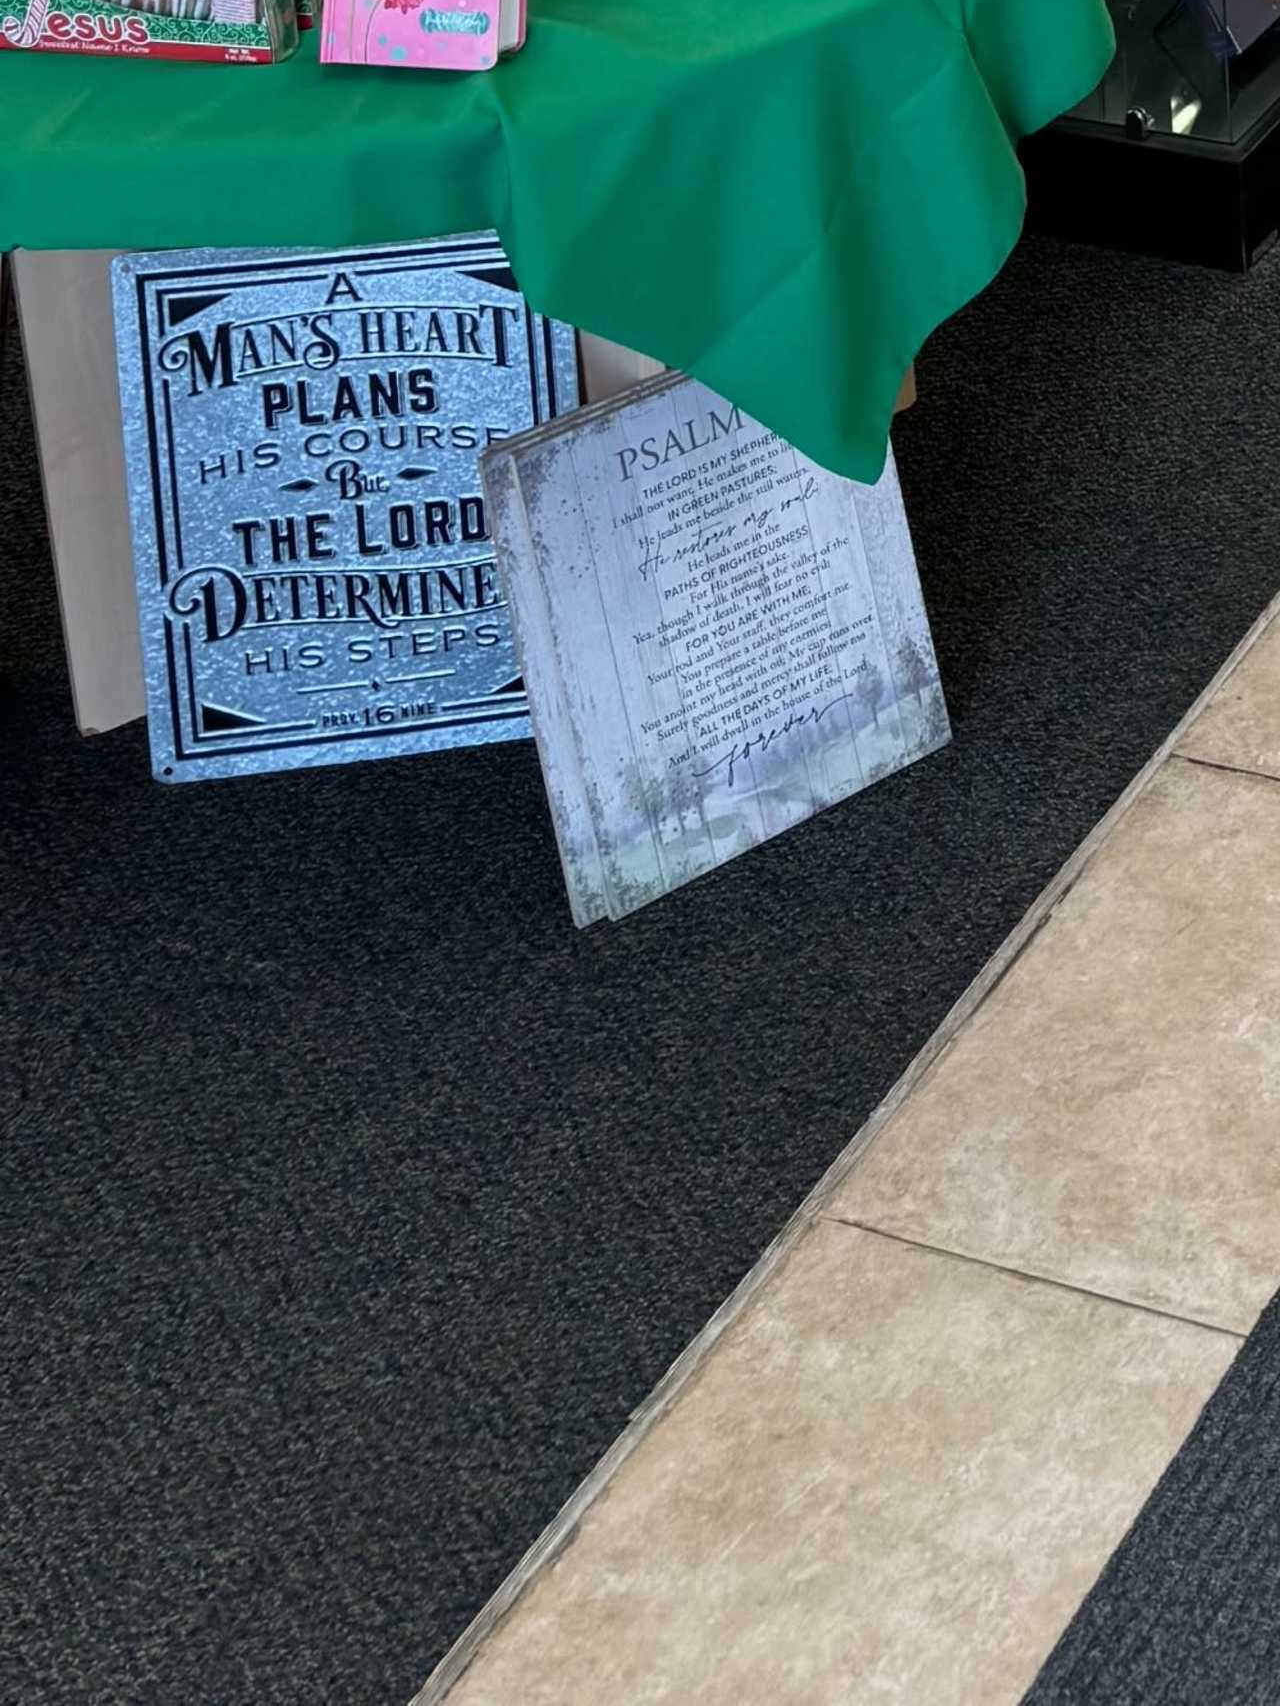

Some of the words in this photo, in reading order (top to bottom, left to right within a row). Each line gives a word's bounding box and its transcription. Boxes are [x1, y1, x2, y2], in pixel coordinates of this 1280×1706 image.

[326, 272, 364, 304] A
[158, 312, 340, 397] MAN'S
[359, 303, 520, 368] HEART
[261, 367, 441, 430] PLANS
[201, 442, 282, 484] HIS
[615, 405, 747, 482] PSALM
[324, 458, 391, 500] But
[642, 483, 664, 500] THE
[665, 468, 697, 489] LORD
[710, 456, 728, 471] MY
[682, 491, 720, 515] GREEN
[233, 512, 336, 566] THE
[355, 496, 494, 557] LORD
[664, 577, 699, 600] PATHS
[701, 568, 717, 583] OF
[719, 525, 809, 574] RIGHTEOUSNESS
[170, 561, 498, 643] DETERMINE
[686, 634, 709, 652] FOR
[712, 623, 736, 640] YOU
[738, 611, 759, 627] ARE
[761, 595, 789, 619] WITH
[245, 641, 324, 675] HIS
[347, 623, 502, 663] STEPS
[362, 705, 396, 727] 16
[401, 702, 437, 719] NINE
[700, 723, 719, 738] ALL
[721, 712, 742, 727] THE
[743, 695, 771, 716] DAYS
[773, 687, 788, 699] OF
[789, 677, 806, 693] MY
[809, 664, 833, 682] LIFE.
[692, 693, 853, 787] forever
